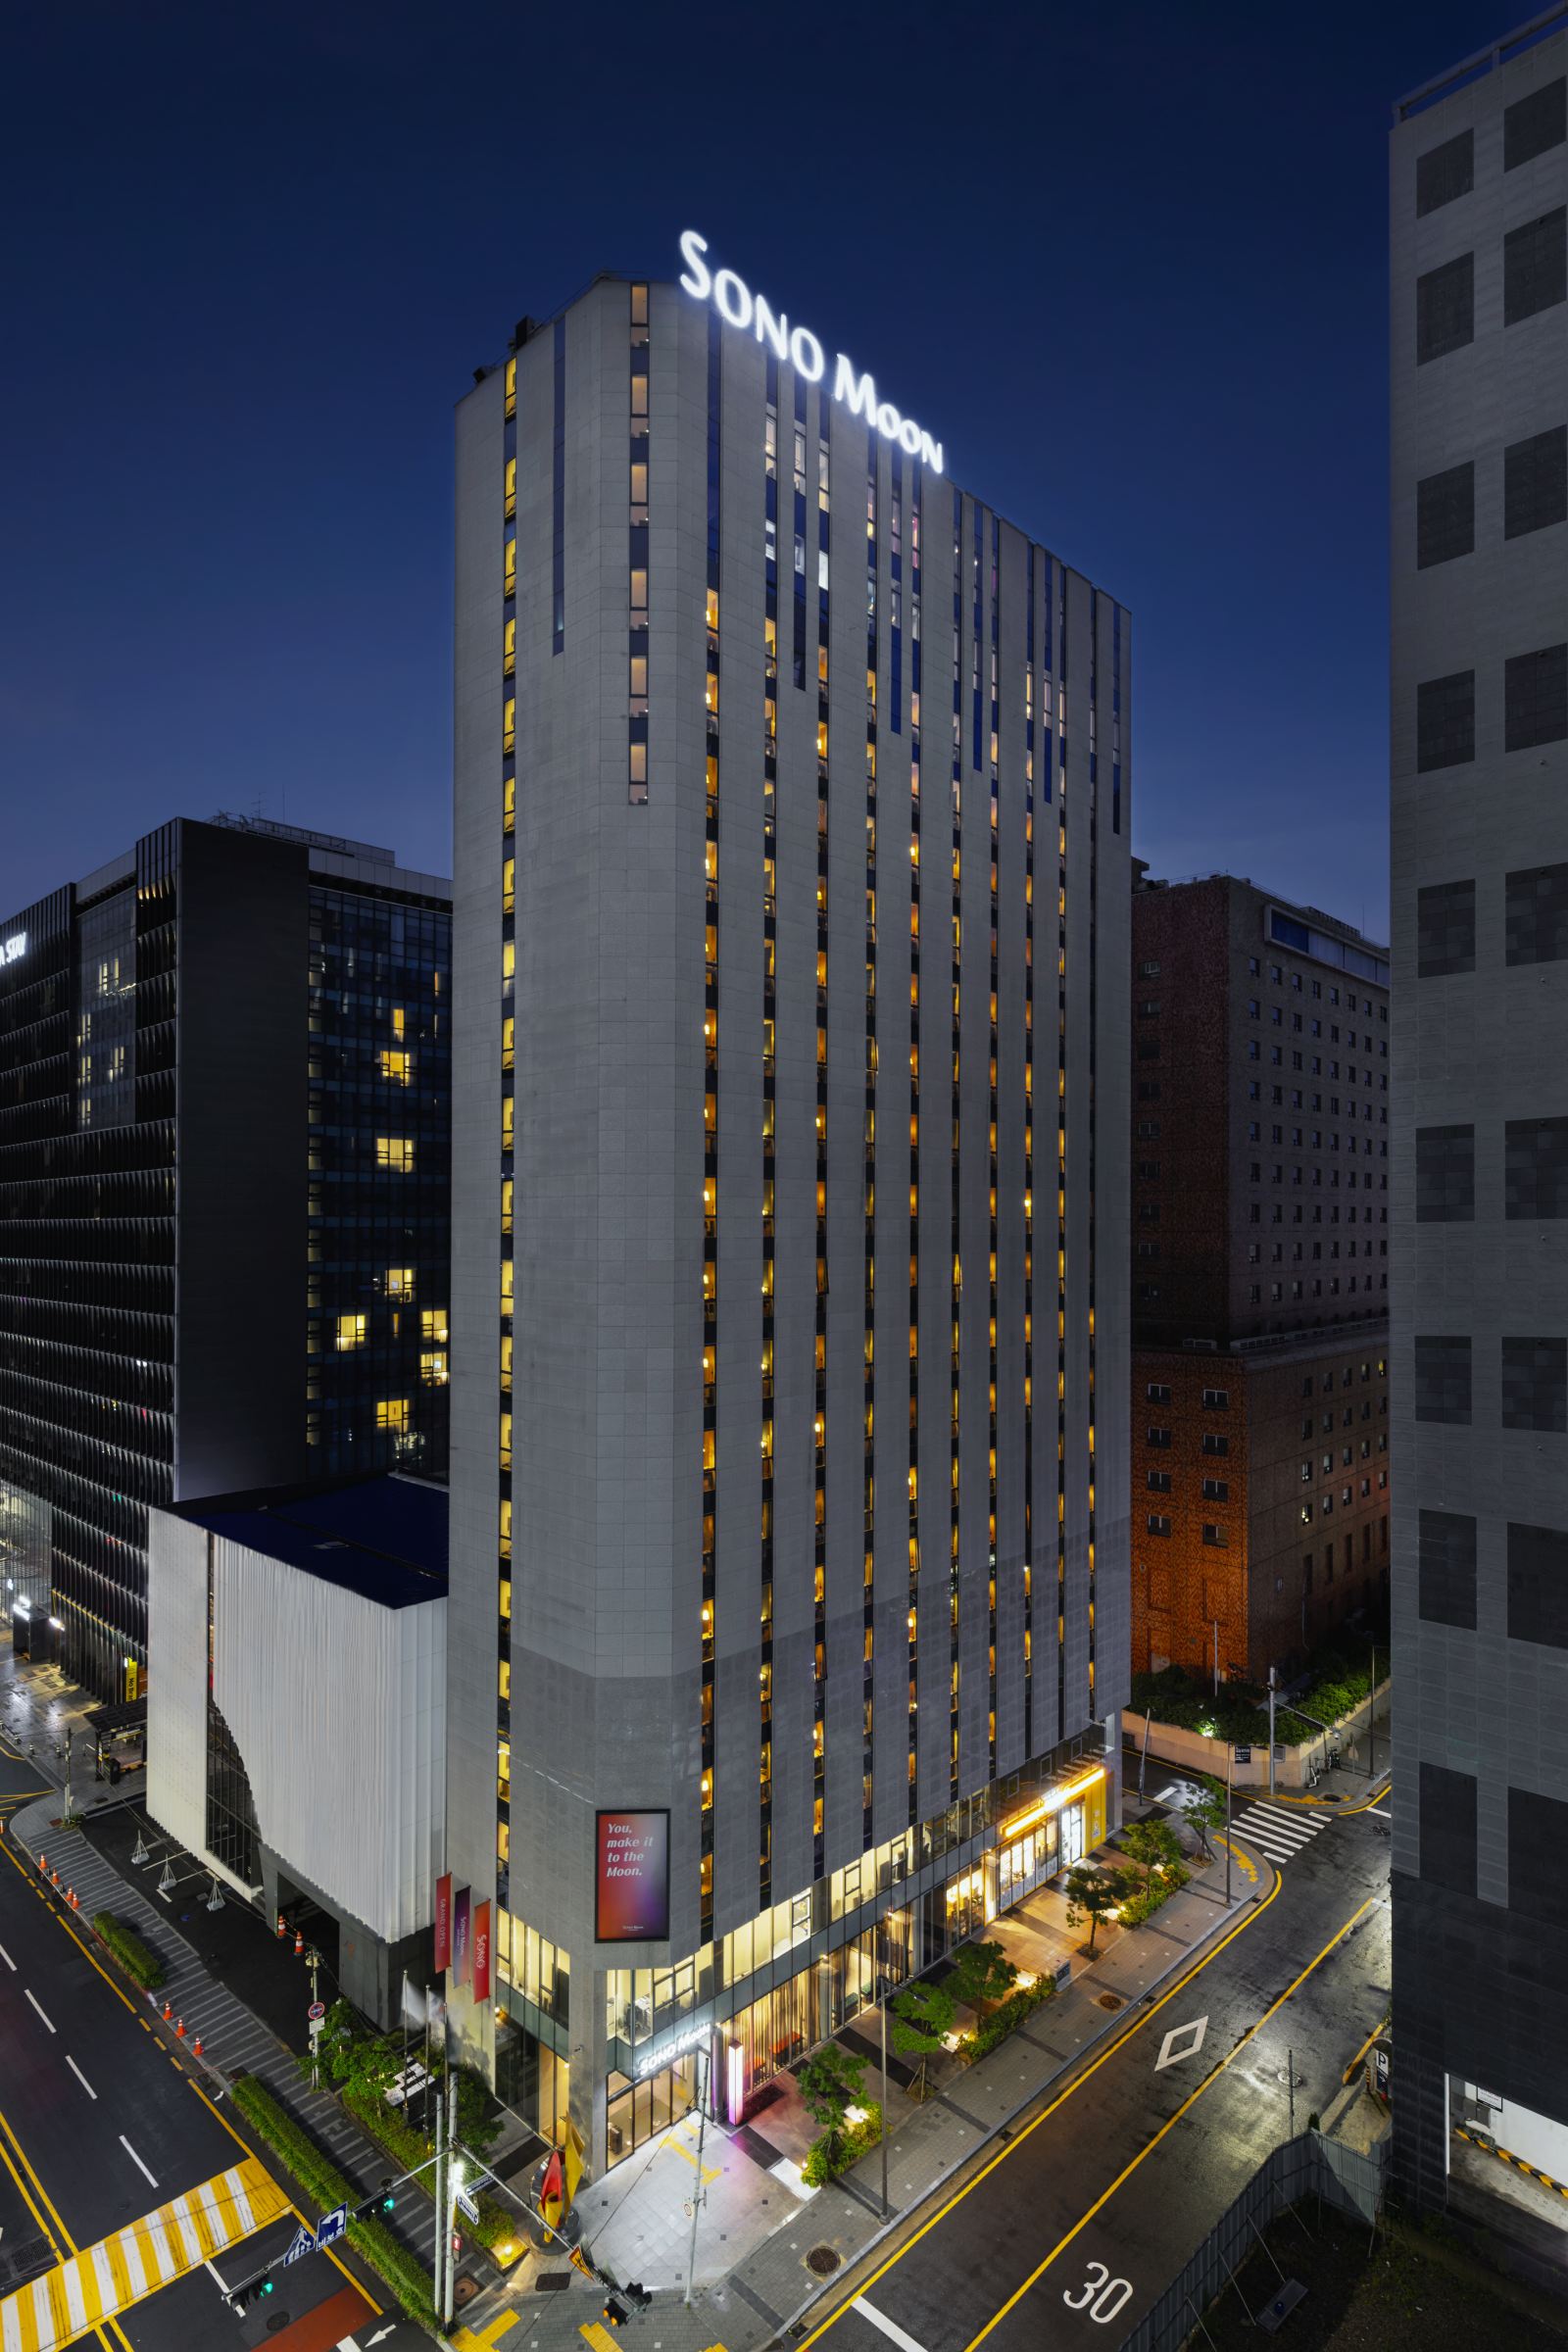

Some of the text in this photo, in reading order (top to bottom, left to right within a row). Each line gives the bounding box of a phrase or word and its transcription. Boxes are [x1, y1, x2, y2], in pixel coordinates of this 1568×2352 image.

[679, 230, 824, 381] SONO
[608, 1823, 632, 1834] You.
[607, 1837, 654, 1848] make it
[608, 1852, 644, 1863] to the
[606, 1866, 643, 1878] Moon.
[476, 1934, 487, 1970] SONO
[639, 2042, 677, 2076] SONO
[1063, 2262, 1133, 2324] 30
